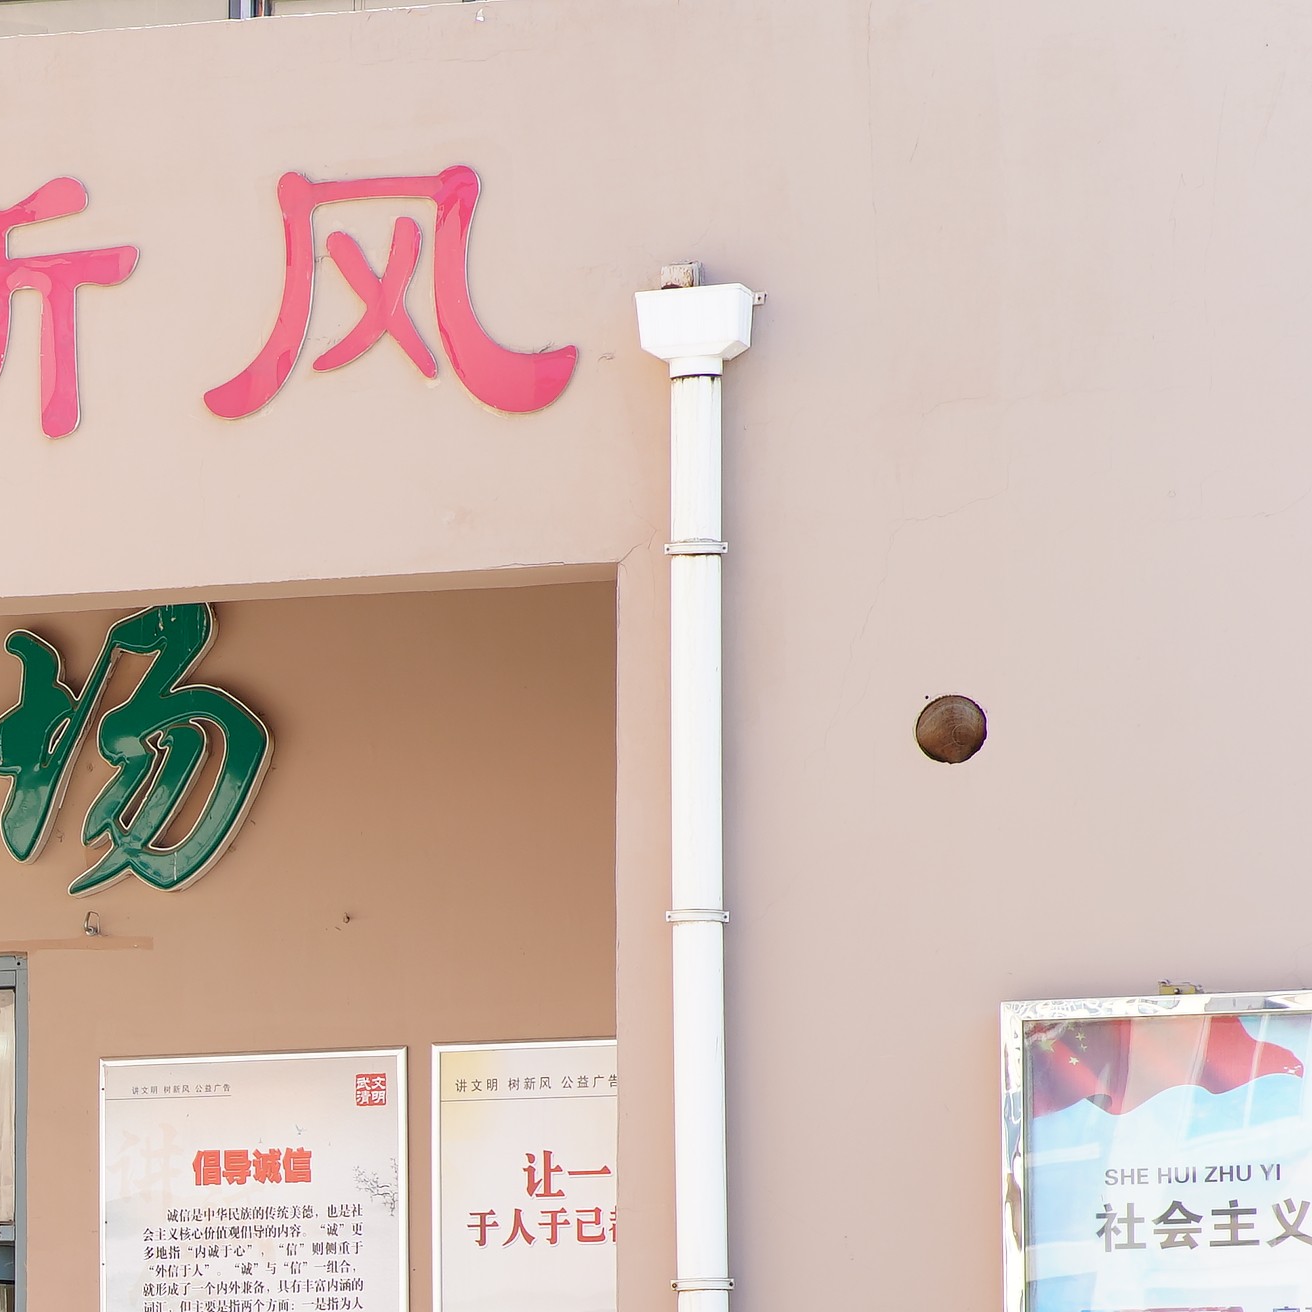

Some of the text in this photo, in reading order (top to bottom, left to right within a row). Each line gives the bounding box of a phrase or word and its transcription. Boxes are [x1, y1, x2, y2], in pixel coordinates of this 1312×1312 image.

[132, 1086, 158, 1095] 讲文明
[195, 1083, 231, 1093] 公益广告
[455, 1078, 498, 1093] 讲文明
[508, 1076, 552, 1091] 树新风
[192, 1147, 312, 1186] 倡导诚信
[523, 1150, 611, 1197] 让一
[1105, 1164, 1281, 1186] SHE HUI ZHU YI
[167, 1203, 363, 1223] 诚信是中华民族的传统美德，也是社
[1096, 1198, 1312, 1252] 社会主义
